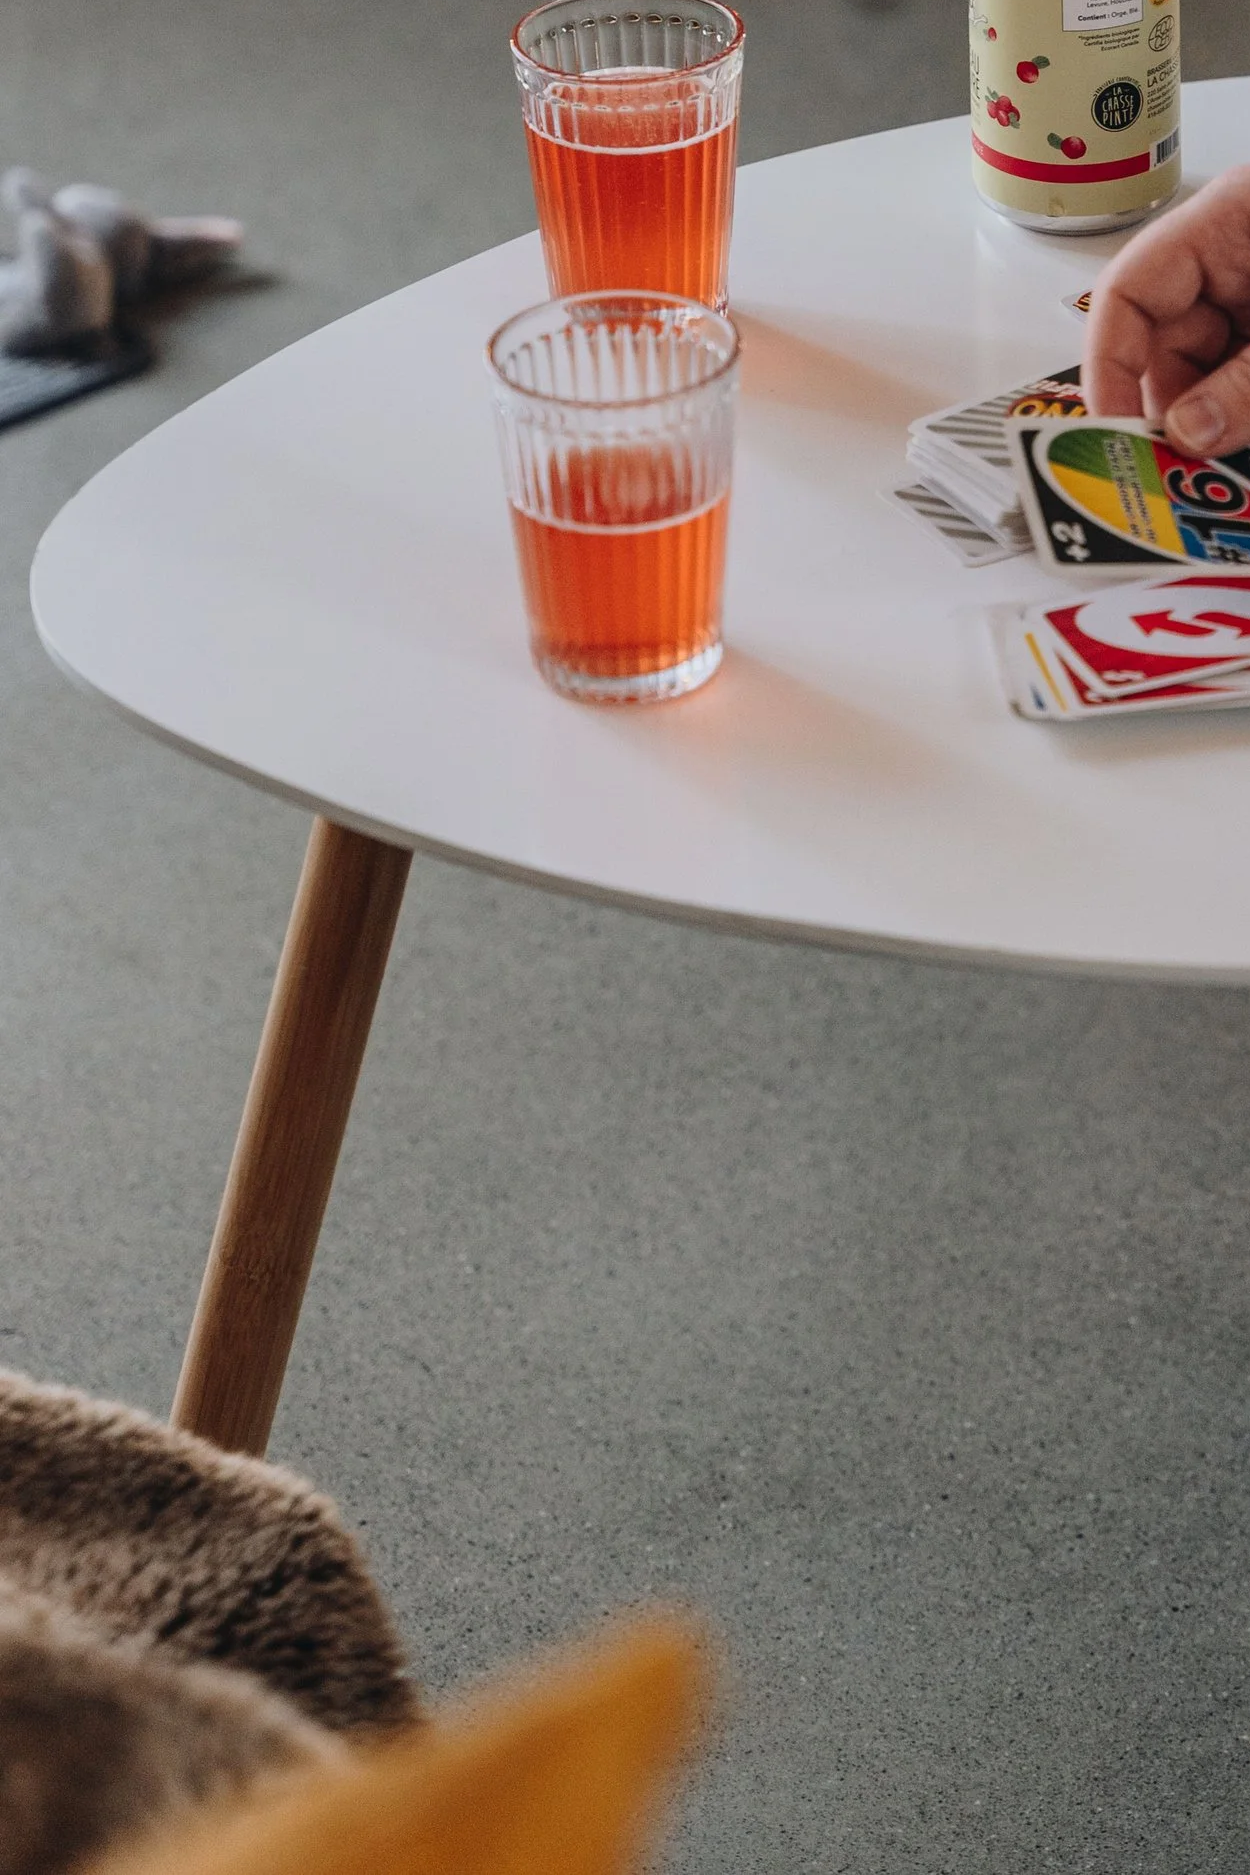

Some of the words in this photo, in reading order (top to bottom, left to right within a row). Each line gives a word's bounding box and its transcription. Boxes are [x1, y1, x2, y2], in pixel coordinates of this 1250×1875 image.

[1113, 86, 1122, 96] LA
[1102, 95, 1134, 112] CHASSE
[1103, 105, 1134, 126] PINTE
[1051, 521, 1090, 562] +2
